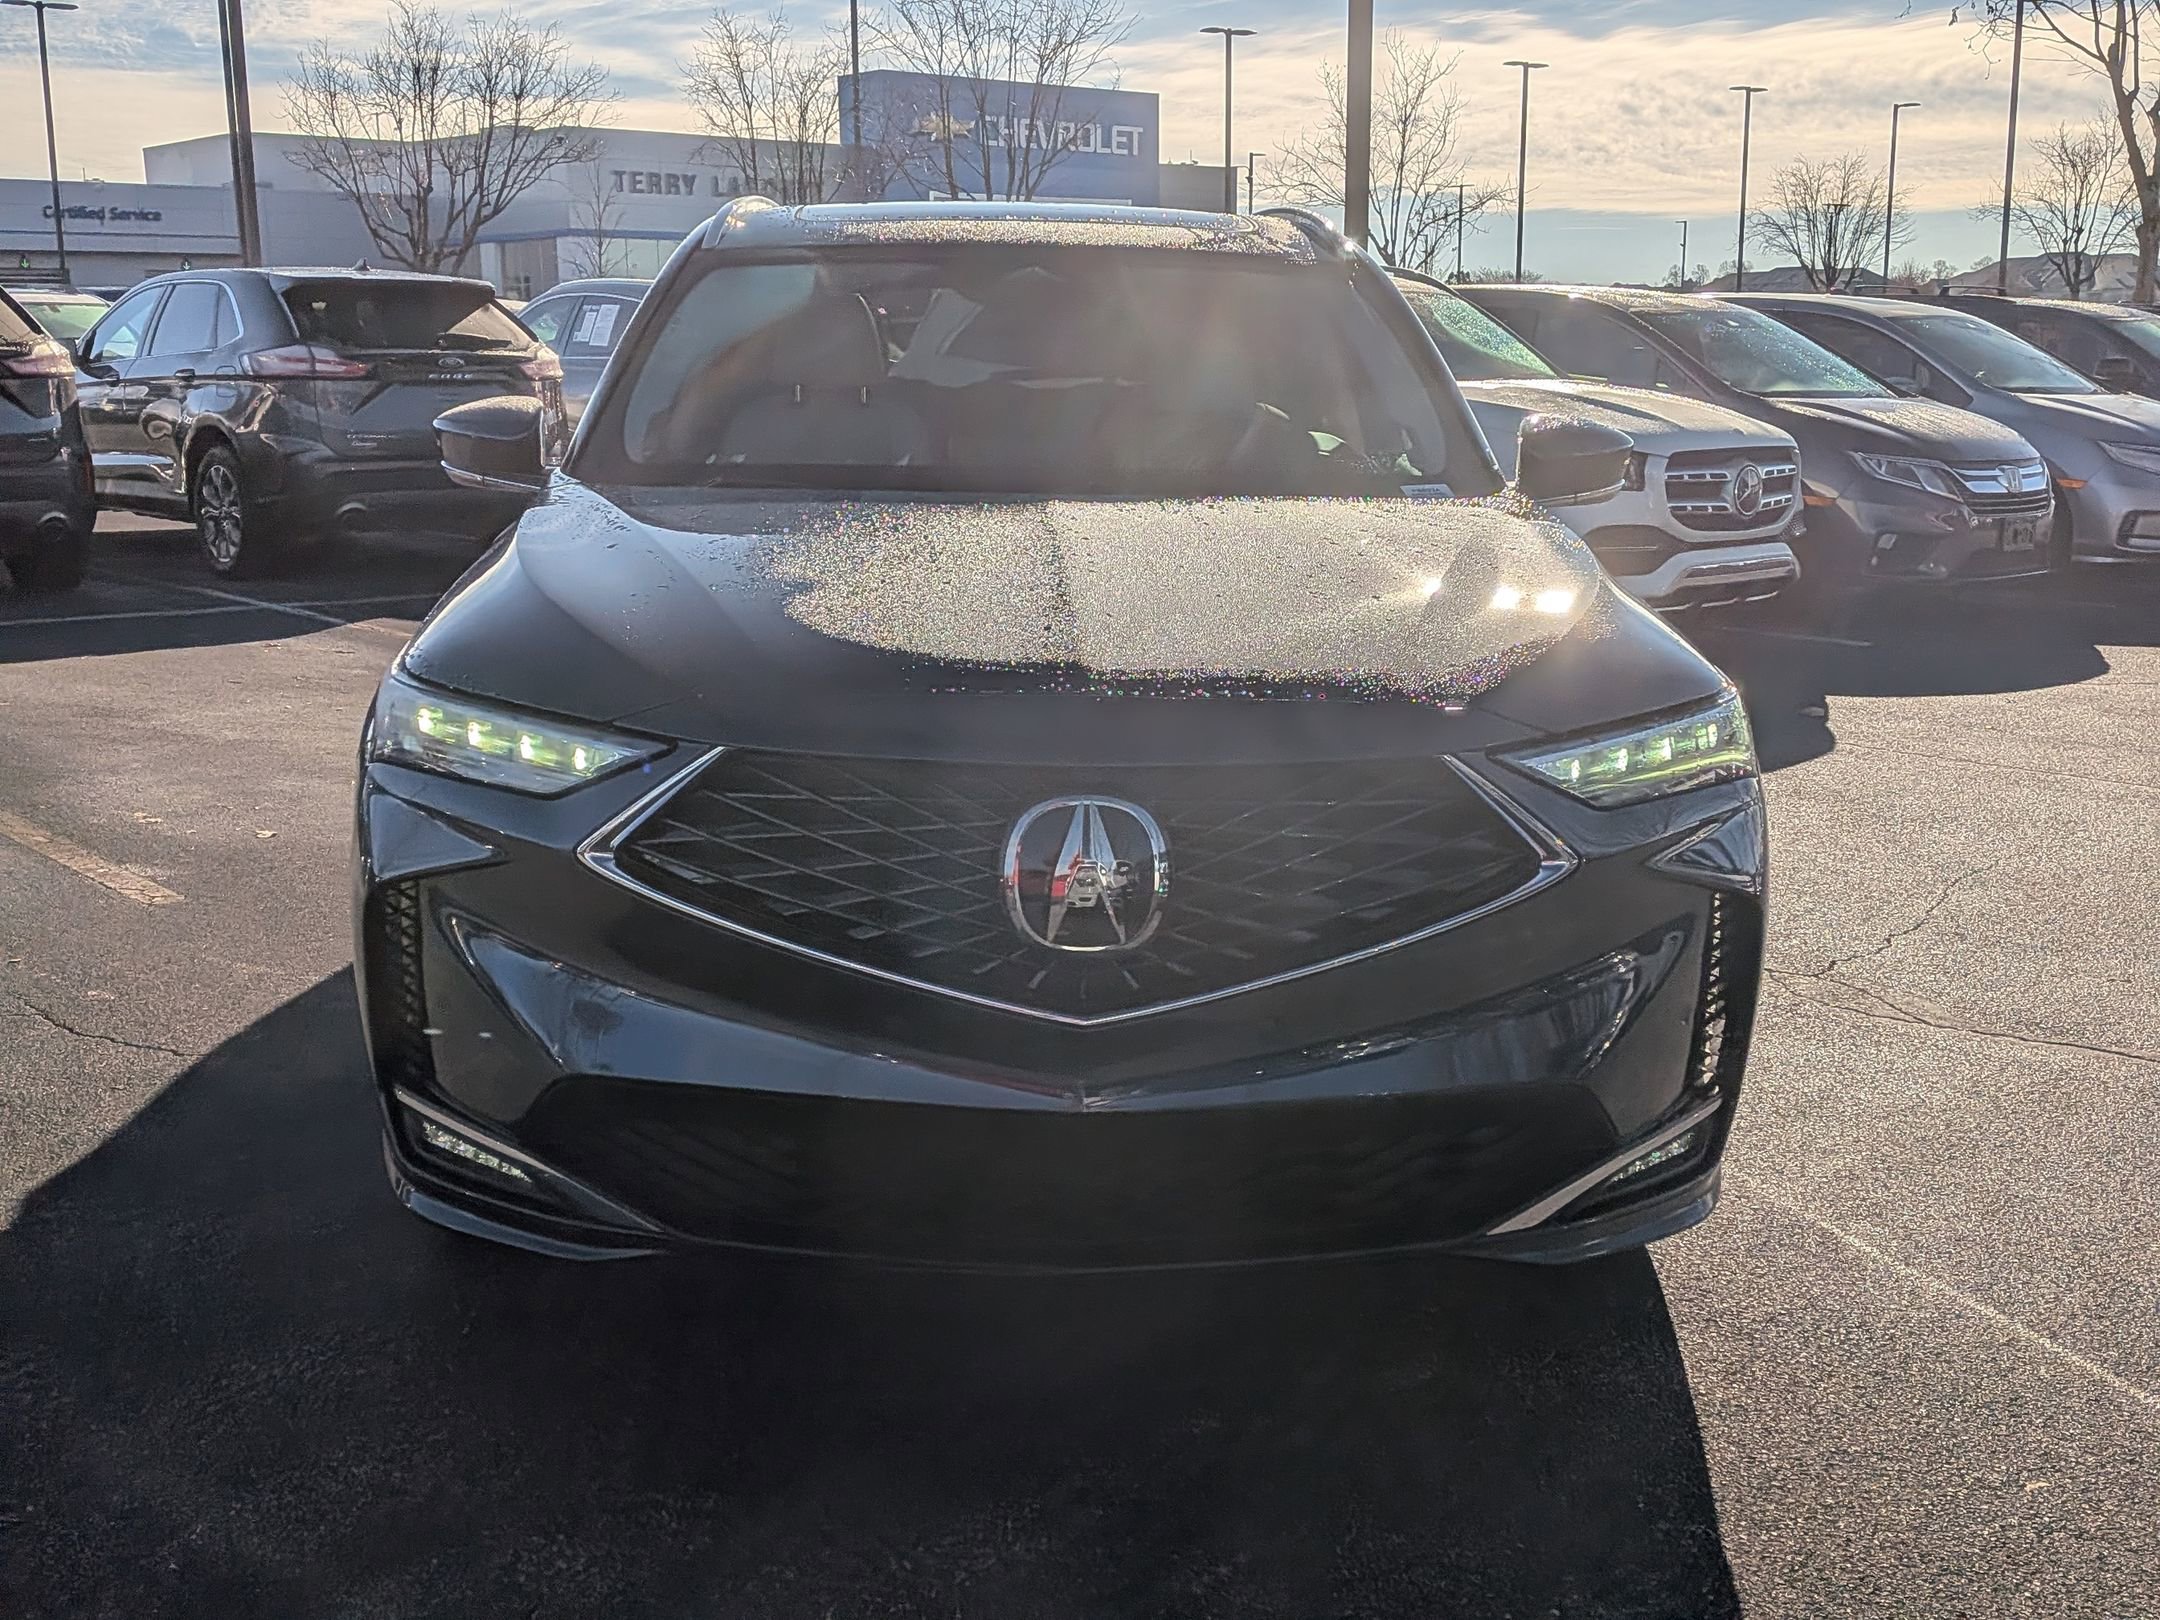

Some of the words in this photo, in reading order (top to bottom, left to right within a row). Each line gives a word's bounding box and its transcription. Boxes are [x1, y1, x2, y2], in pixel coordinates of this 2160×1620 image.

[979, 115, 1144, 156] CHEVROLET
[611, 170, 697, 196] TERRY
[42, 205, 105, 220] Crtified
[109, 207, 162, 221] Service
